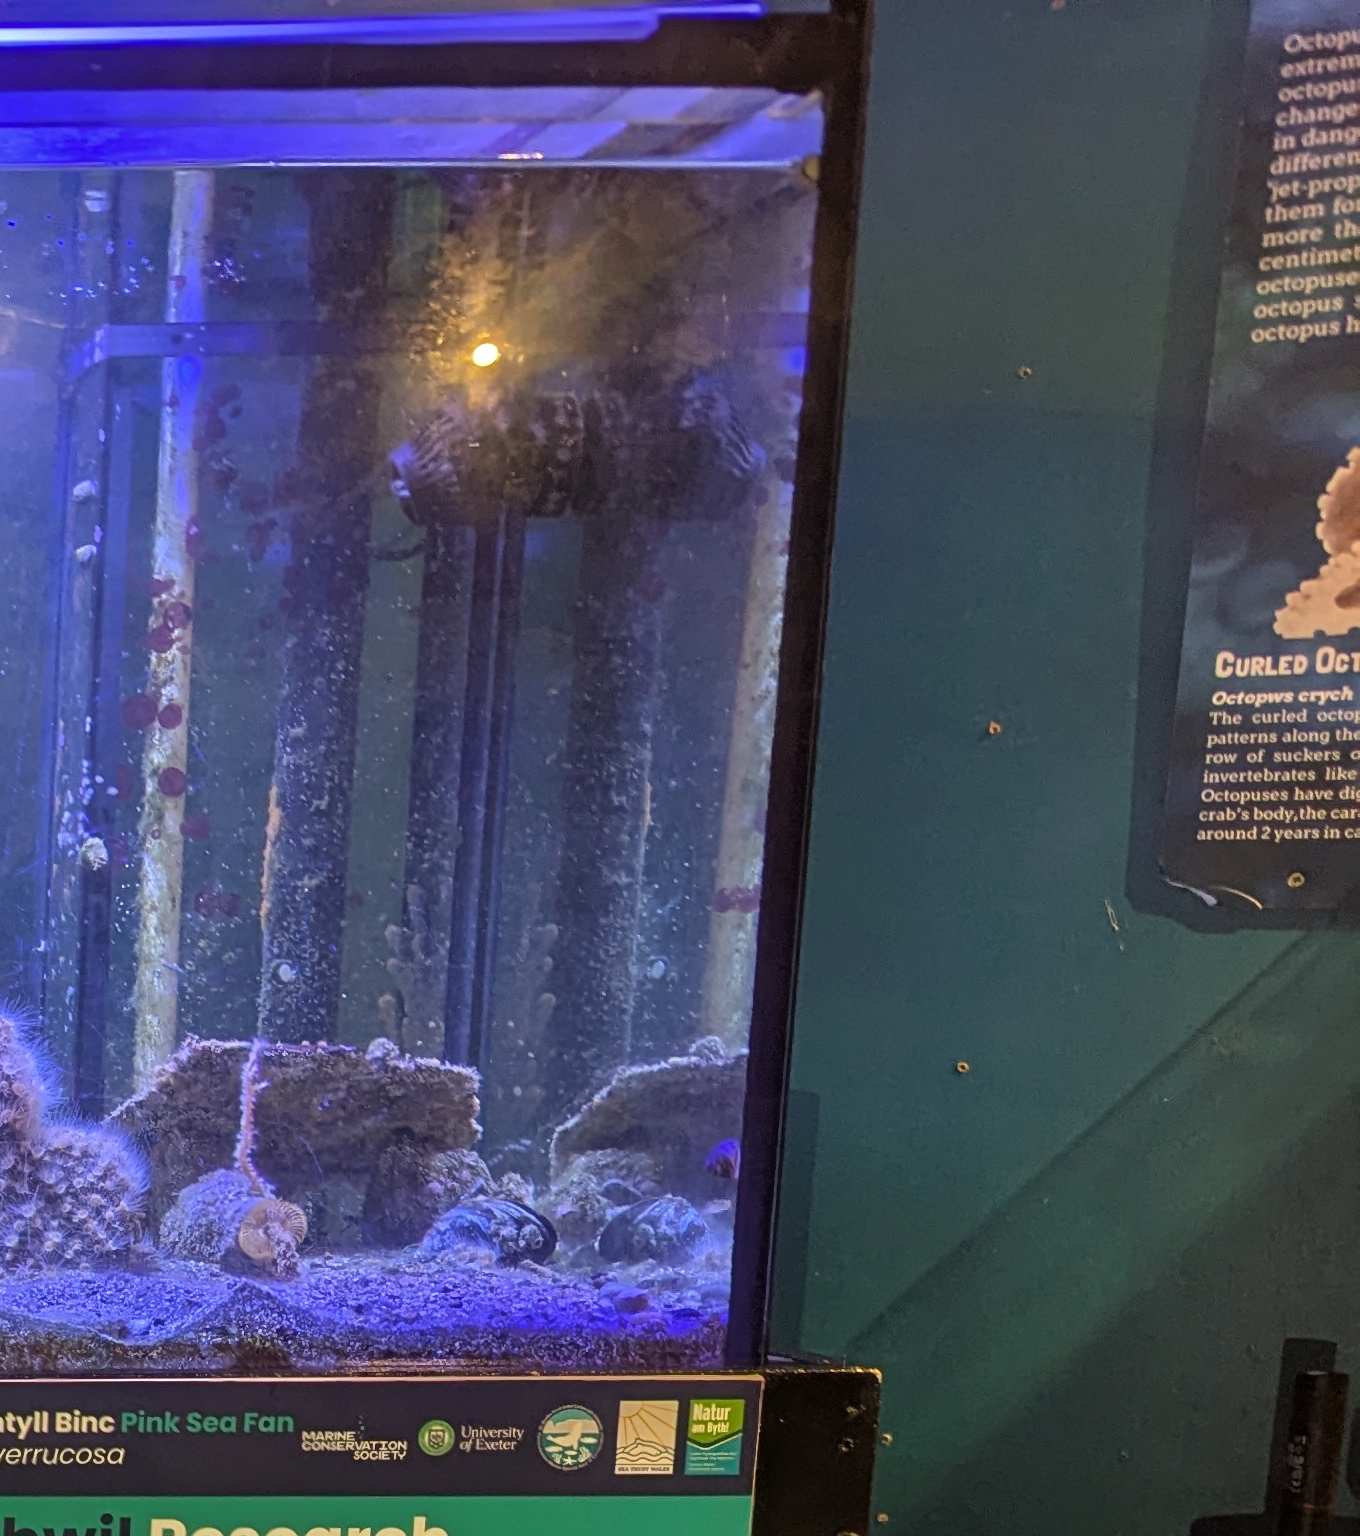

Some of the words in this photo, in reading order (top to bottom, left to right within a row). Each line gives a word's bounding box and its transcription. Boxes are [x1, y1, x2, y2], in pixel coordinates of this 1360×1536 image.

[1265, 203, 1324, 224] them
[1262, 227, 1323, 247] more
[1253, 296, 1344, 319] octopus
[1251, 320, 1341, 343] octopus
[1209, 711, 1242, 725] The
[1252, 708, 1306, 723] curled
[1207, 732, 1277, 748] patterns
[1282, 728, 1330, 744] along
[1205, 753, 1237, 764] row
[1246, 749, 1265, 762] of
[1273, 748, 1339, 761] suckers
[1203, 768, 1315, 782] invertebrates
[1325, 766, 1357, 780] like
[1201, 788, 1288, 804] Octopuses
[1294, 787, 1333, 800] have
[1198, 807, 1249, 821] crab's
[1196, 826, 1257, 840] around
[1261, 826, 1271, 839] 2
[1274, 828, 1319, 842] years
[1323, 825, 1340, 839] in
[55, 1409, 115, 1433] Binc
[122, 1412, 179, 1432] Pink
[187, 1412, 235, 1432] Sea
[244, 1413, 293, 1431] Fan
[692, 1403, 731, 1422] Natur
[302, 1431, 355, 1441] MARINE
[460, 1425, 525, 1441] University
[708, 1422, 730, 1436] Byth!
[302, 1441, 407, 1451] CONSERVATION
[459, 1439, 473, 1452] of
[476, 1440, 518, 1451] Exeter
[353, 1450, 407, 1461] SOCIETY
